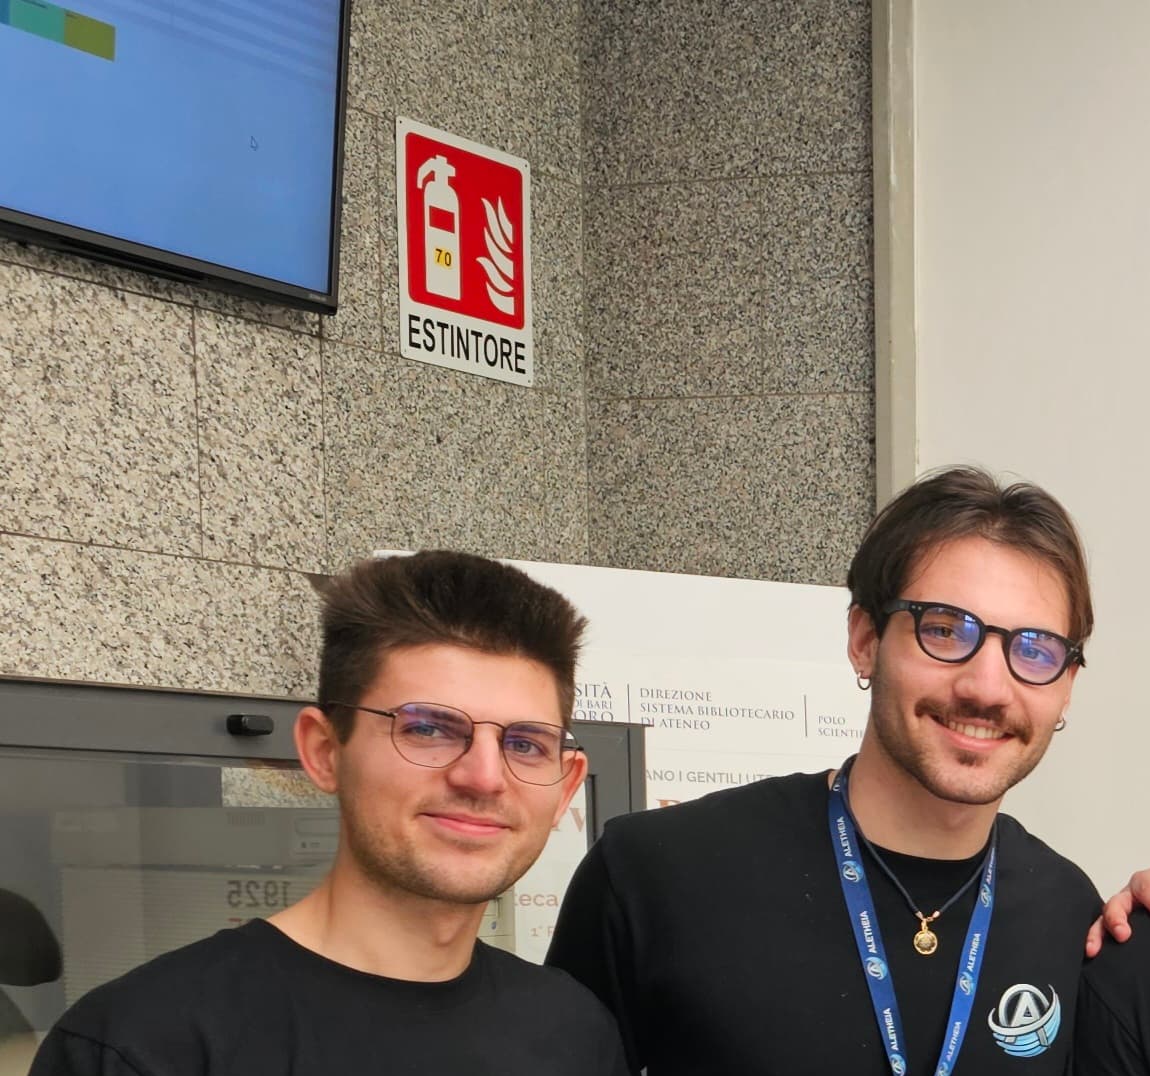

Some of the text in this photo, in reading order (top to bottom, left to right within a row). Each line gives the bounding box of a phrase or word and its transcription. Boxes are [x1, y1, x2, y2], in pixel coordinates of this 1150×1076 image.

[435, 248, 452, 267] 70
[408, 314, 526, 374] ESTINTORE
[574, 682, 612, 699] SITÀ
[639, 687, 712, 702] DIREZIONE
[587, 700, 612, 710] BARI
[640, 702, 795, 721] SISTEMA BIBLIOTECARIO
[659, 718, 711, 731] ATENEO
[818, 715, 846, 725] POLO
[686, 771, 742, 784] GENTILI
[860, 910, 877, 954] ALETHEIA
[966, 932, 982, 973] ALETHEIA
[884, 1006, 900, 1051] ALETHEIA
[945, 1020, 962, 1062] ALETHEIA
